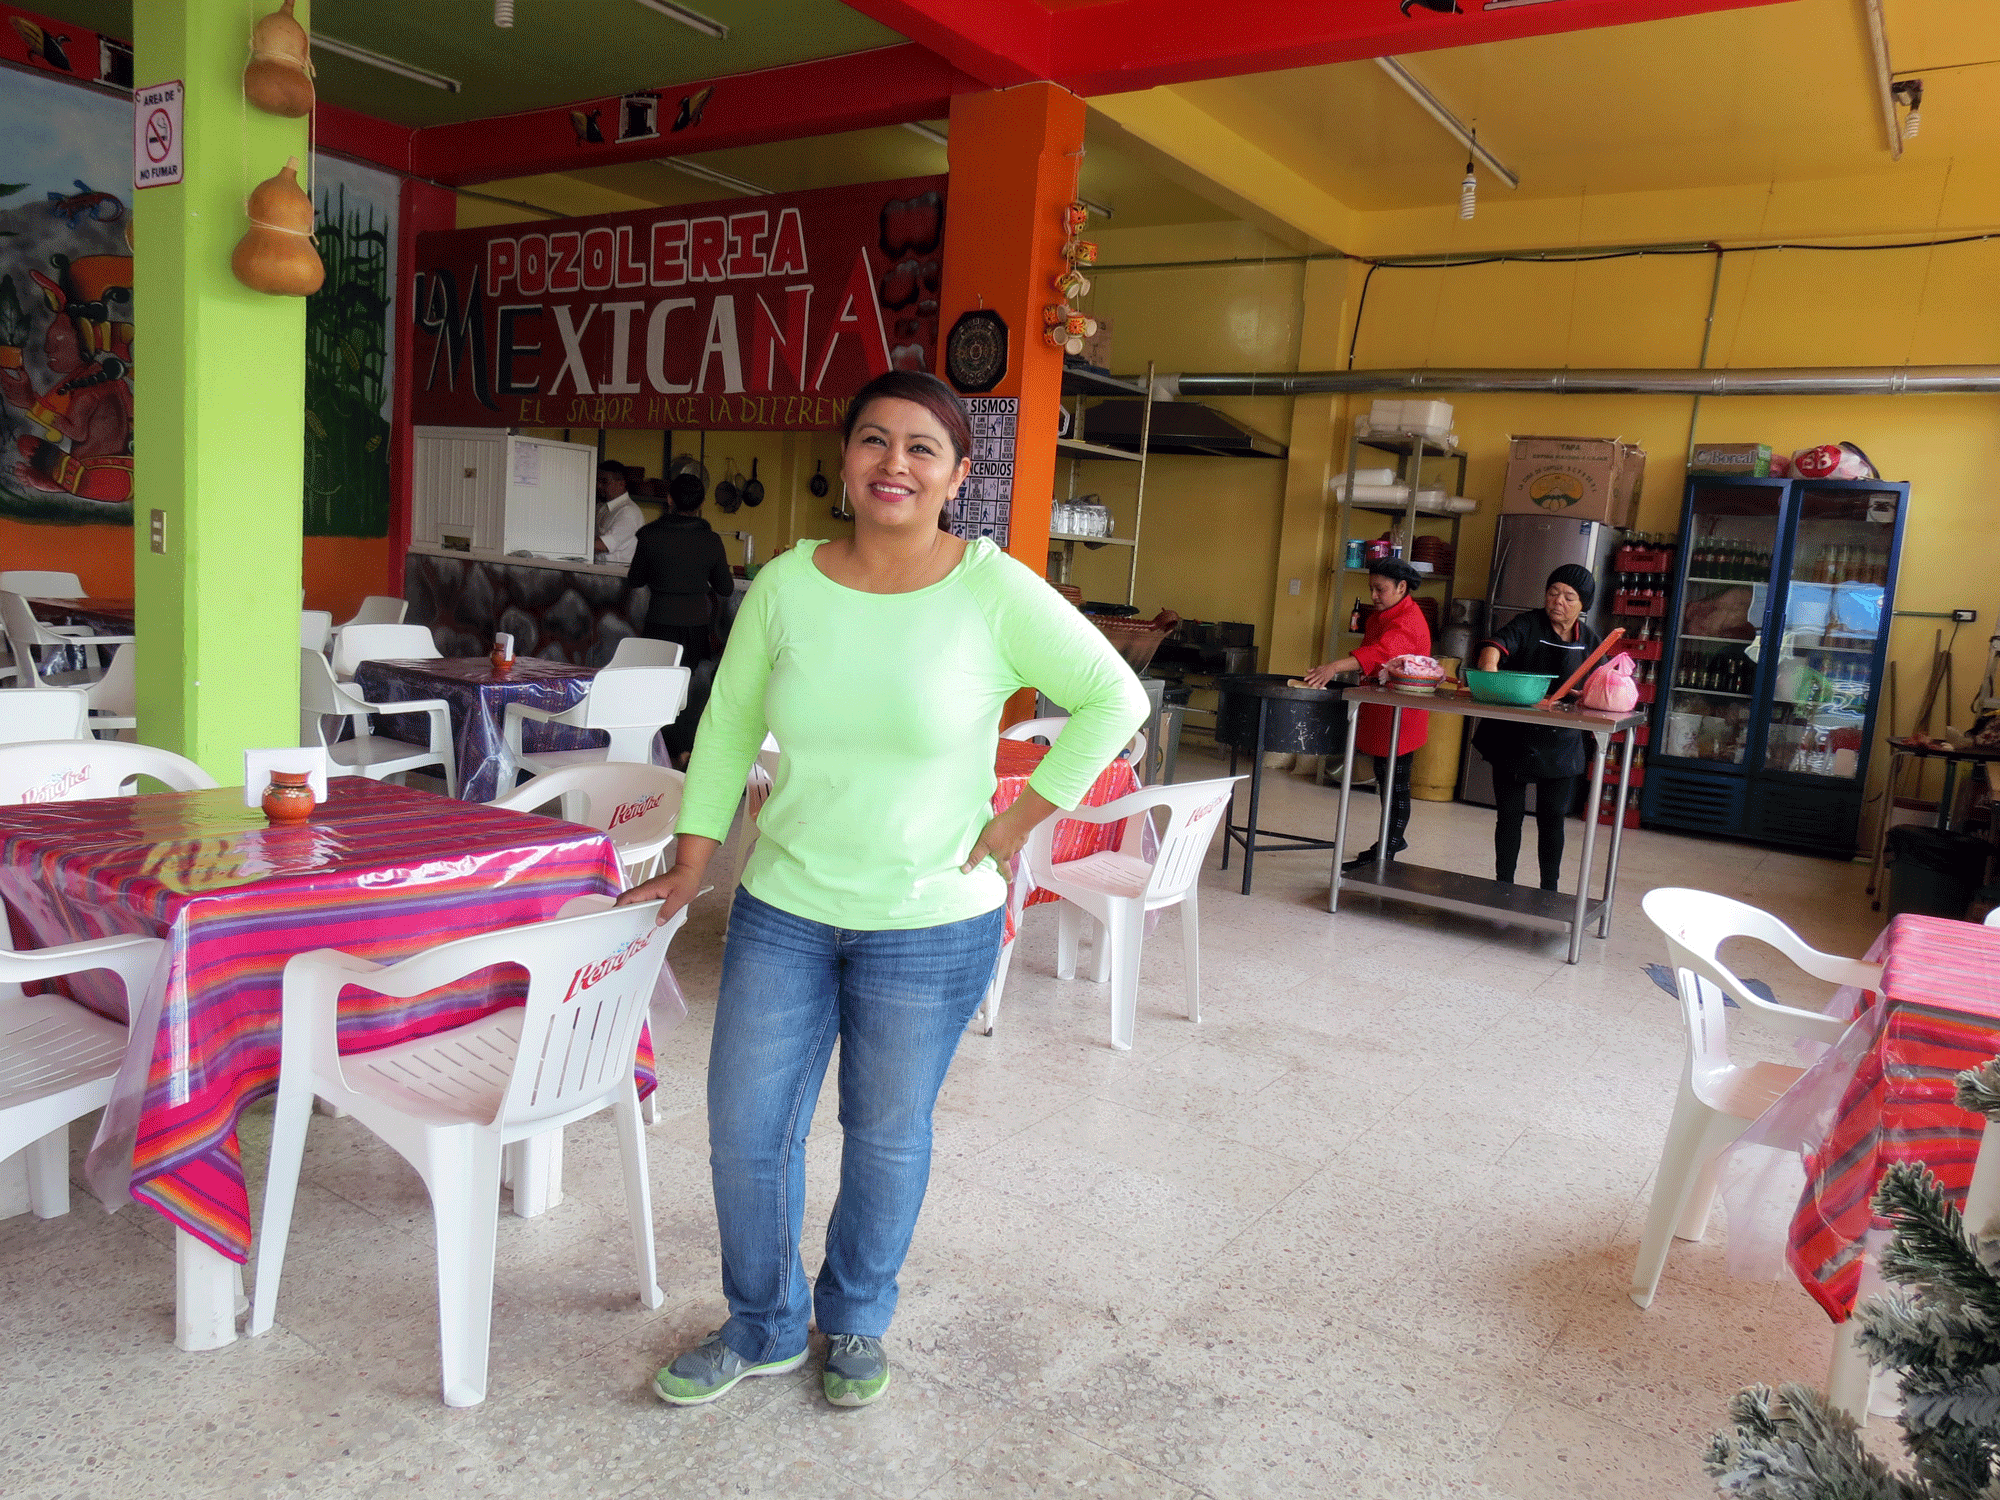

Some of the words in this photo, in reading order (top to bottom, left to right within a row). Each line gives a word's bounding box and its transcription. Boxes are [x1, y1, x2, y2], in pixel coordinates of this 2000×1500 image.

[144, 93, 163, 106] AREA
[164, 90, 174, 101] DE
[140, 169, 150, 180] NO
[151, 165, 178, 178] FUMAR
[487, 208, 808, 297] POZOLERIA
[427, 246, 894, 412] MEXICANA
[518, 398, 545, 424] EL
[567, 397, 635, 424] SABOR
[649, 397, 700, 423] HACE
[710, 395, 733, 422] LA
[970, 399, 1016, 414] SISMOS
[1711, 449, 1757, 465] Boreal
[969, 462, 1012, 477] NCENDIOS
